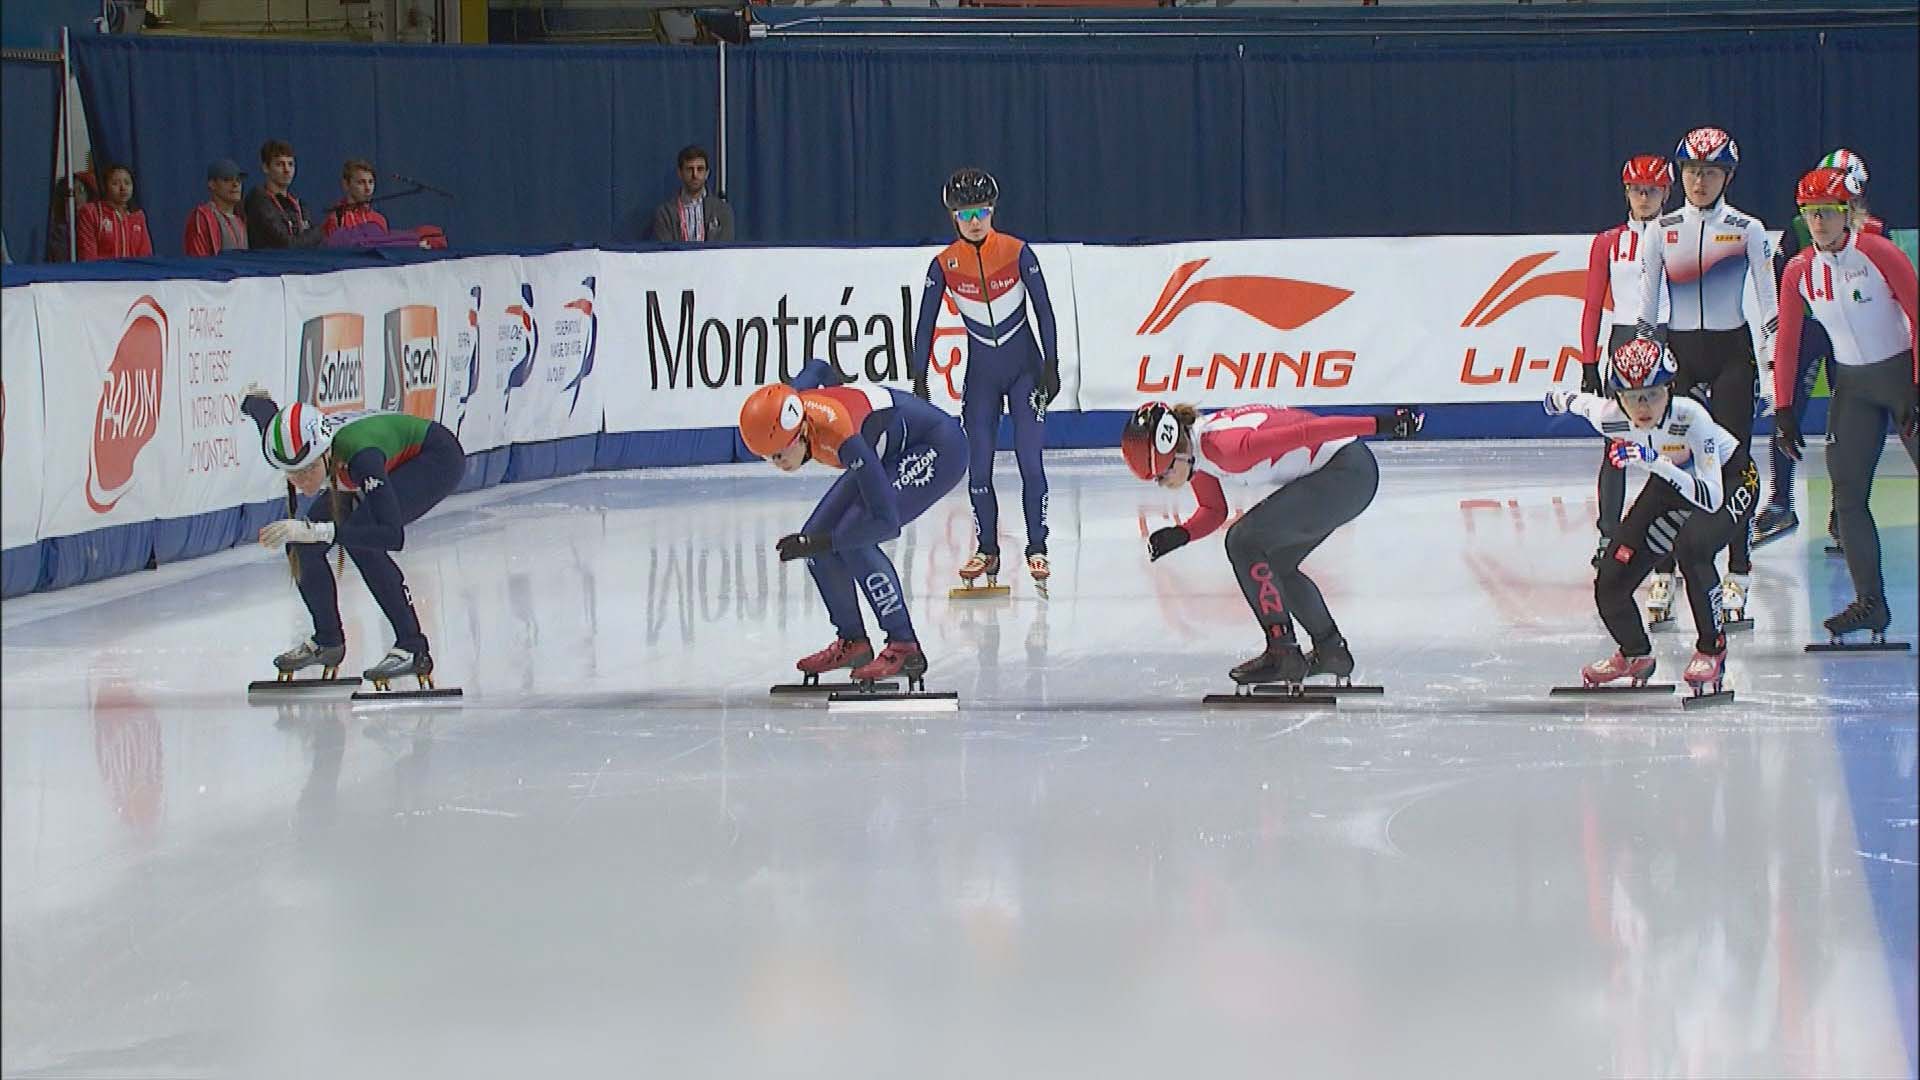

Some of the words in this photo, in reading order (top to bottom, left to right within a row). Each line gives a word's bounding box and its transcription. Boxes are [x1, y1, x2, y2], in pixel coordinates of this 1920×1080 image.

[645, 285, 917, 391] Montréal
[1136, 350, 1357, 393] LI-NING
[788, 403, 799, 418] 7
[1160, 422, 1176, 445] 24
[892, 447, 939, 491] TONZON
[1725, 486, 1752, 524] KB
[865, 571, 903, 617] NED
[1249, 561, 1284, 616] CAN
